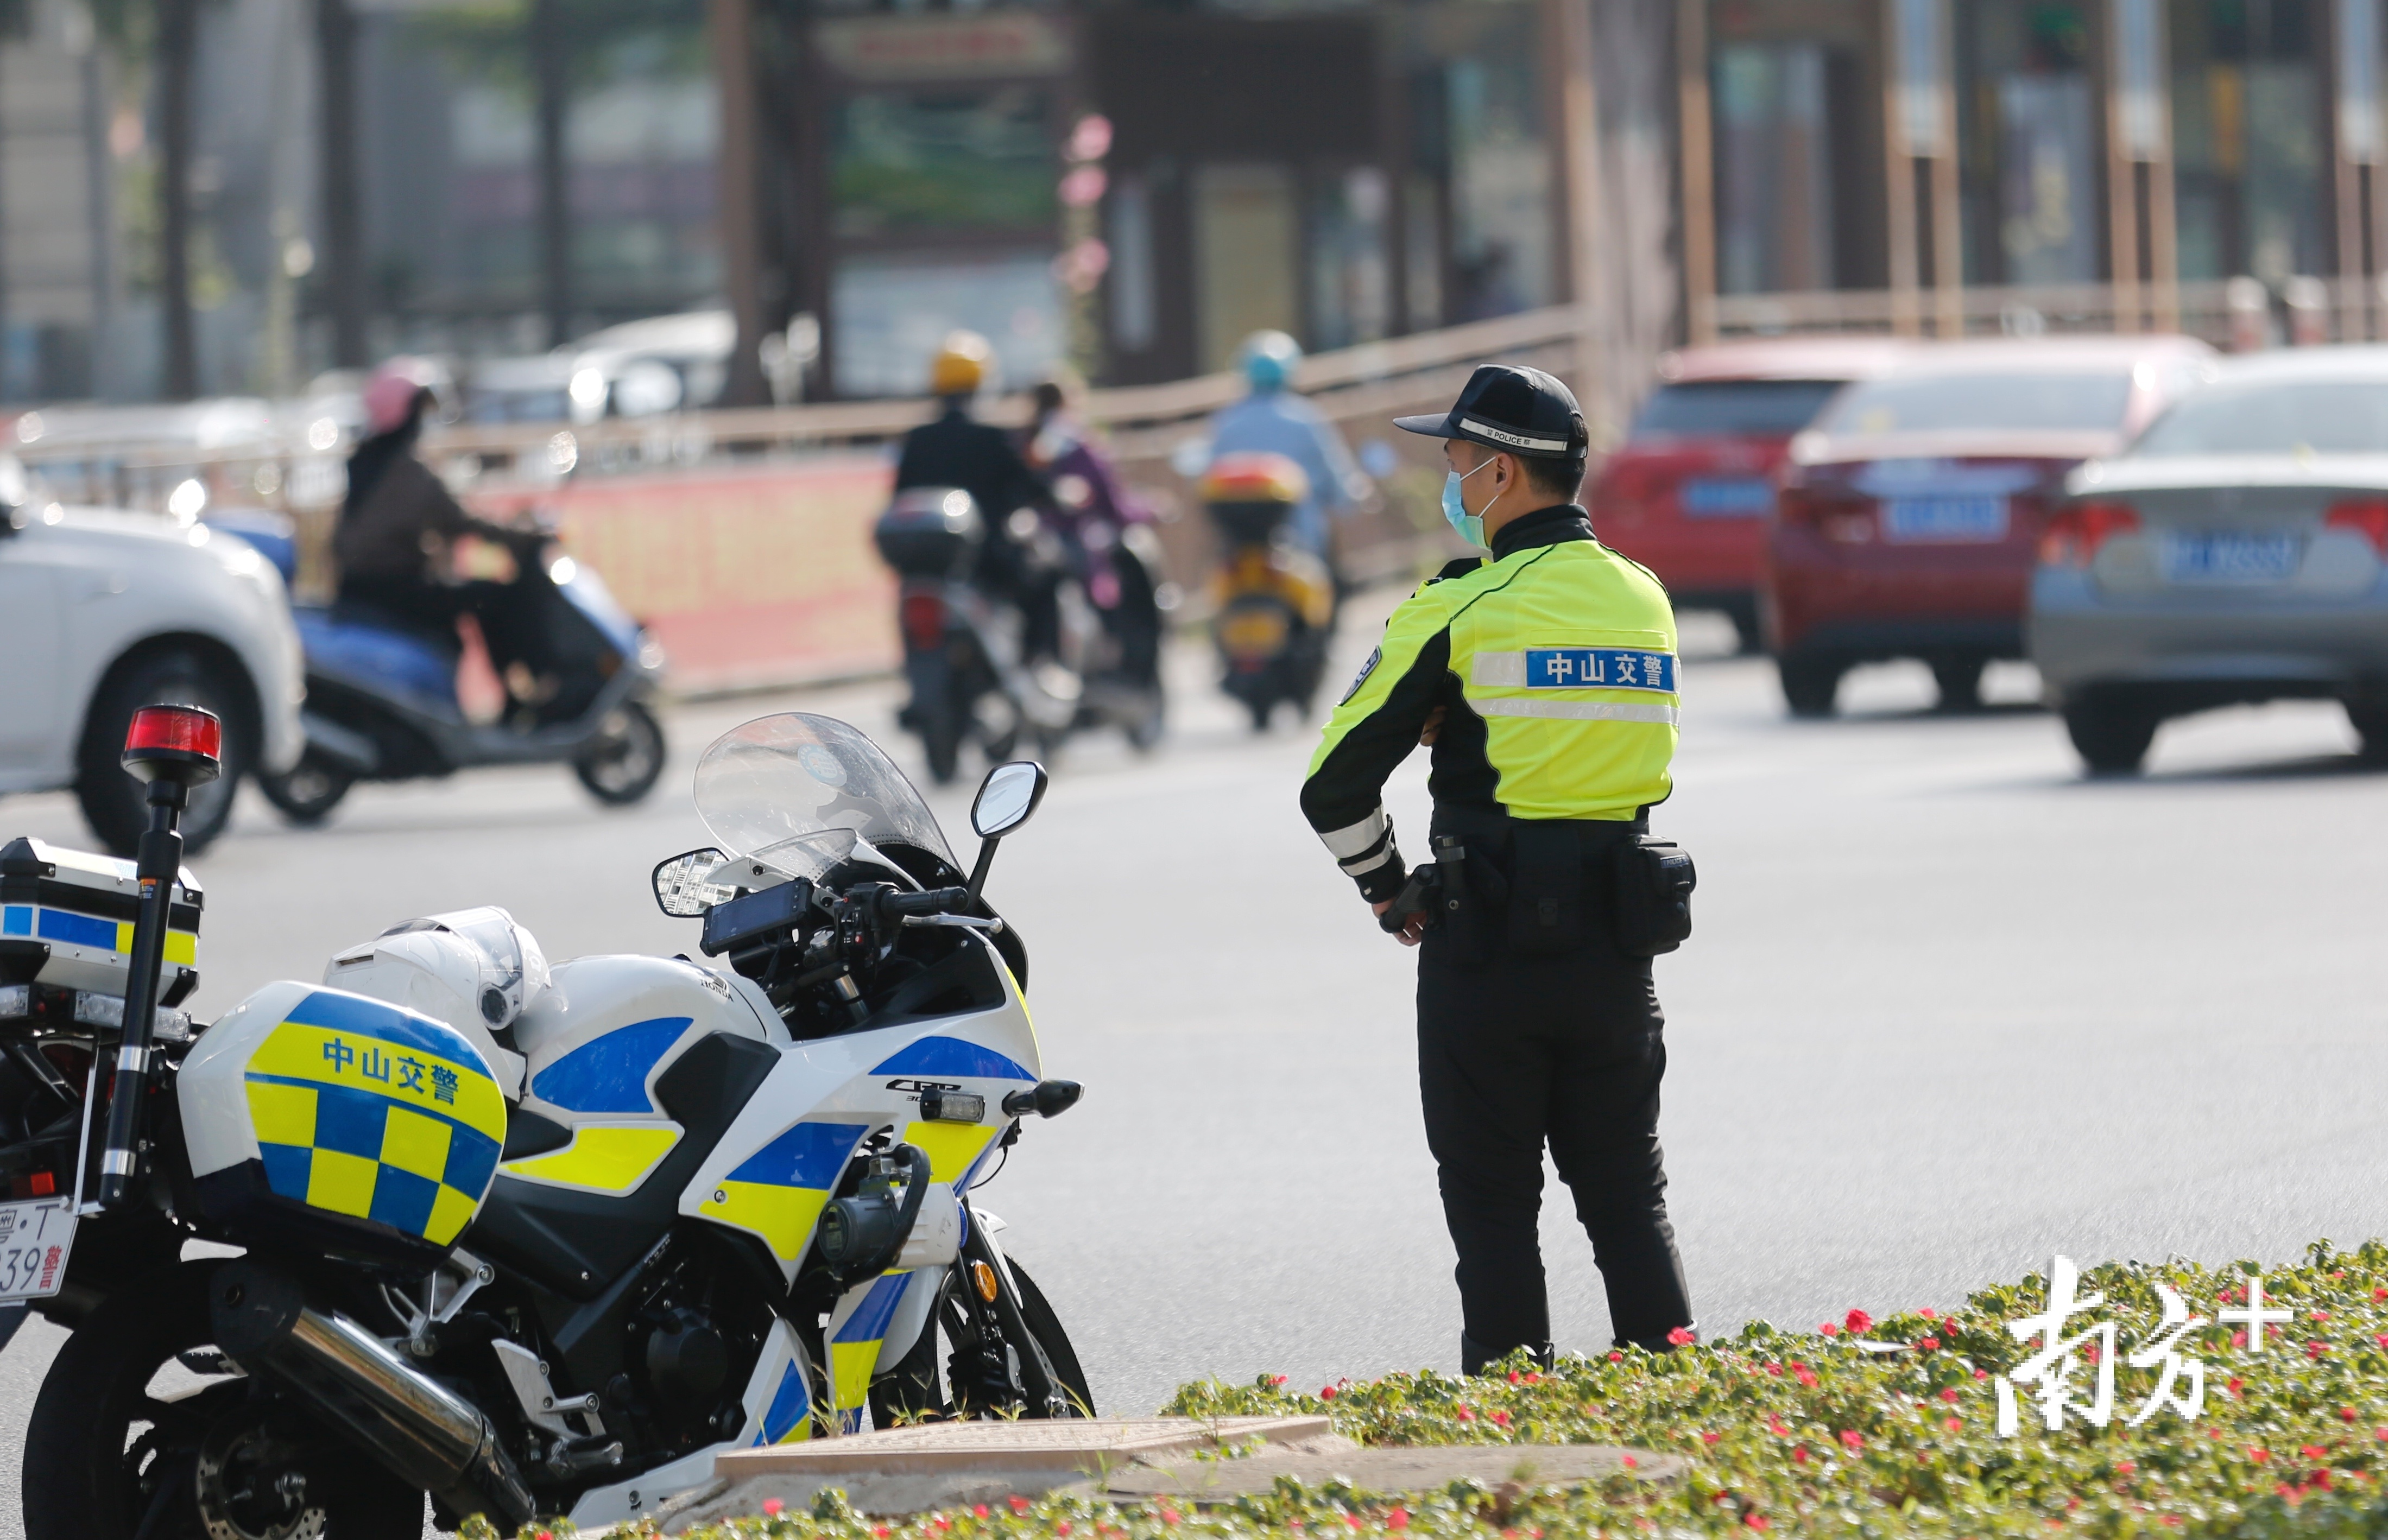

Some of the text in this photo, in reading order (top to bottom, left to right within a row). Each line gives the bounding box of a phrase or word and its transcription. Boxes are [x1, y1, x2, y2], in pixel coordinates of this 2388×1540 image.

[1494, 432, 1522, 445] POLICE
[1547, 652, 1663, 687] 中山交警
[700, 979, 734, 1003] HONDA
[323, 1037, 458, 1106] 中山交警
[0, 1245, 62, 1290] 39警
